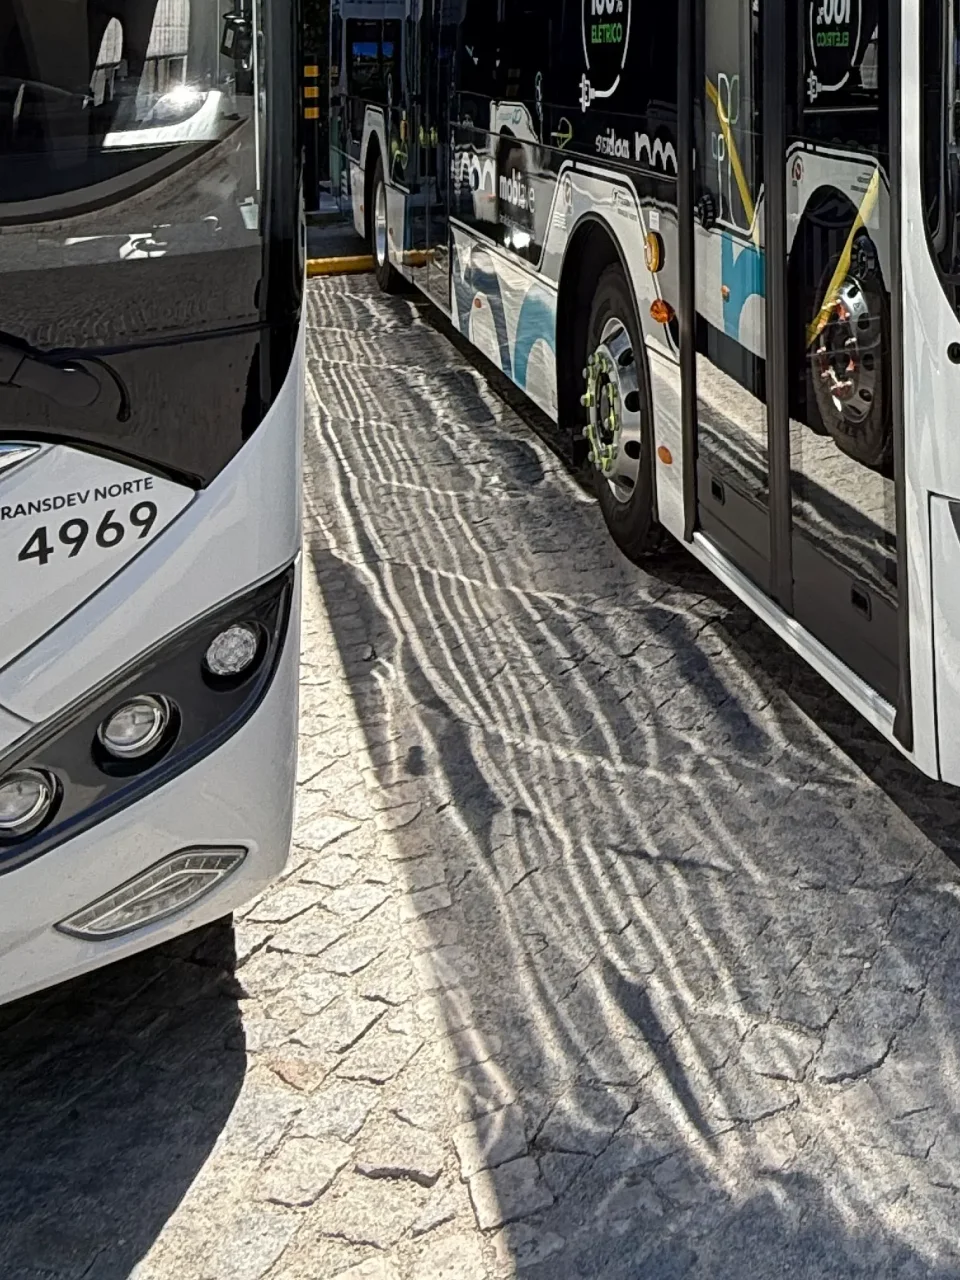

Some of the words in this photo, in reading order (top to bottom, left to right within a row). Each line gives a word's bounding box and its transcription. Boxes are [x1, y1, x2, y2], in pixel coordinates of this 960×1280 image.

[0, 490, 90, 520] RANSDEV
[94, 477, 154, 501] NORTE
[18, 501, 158, 566] 4969
